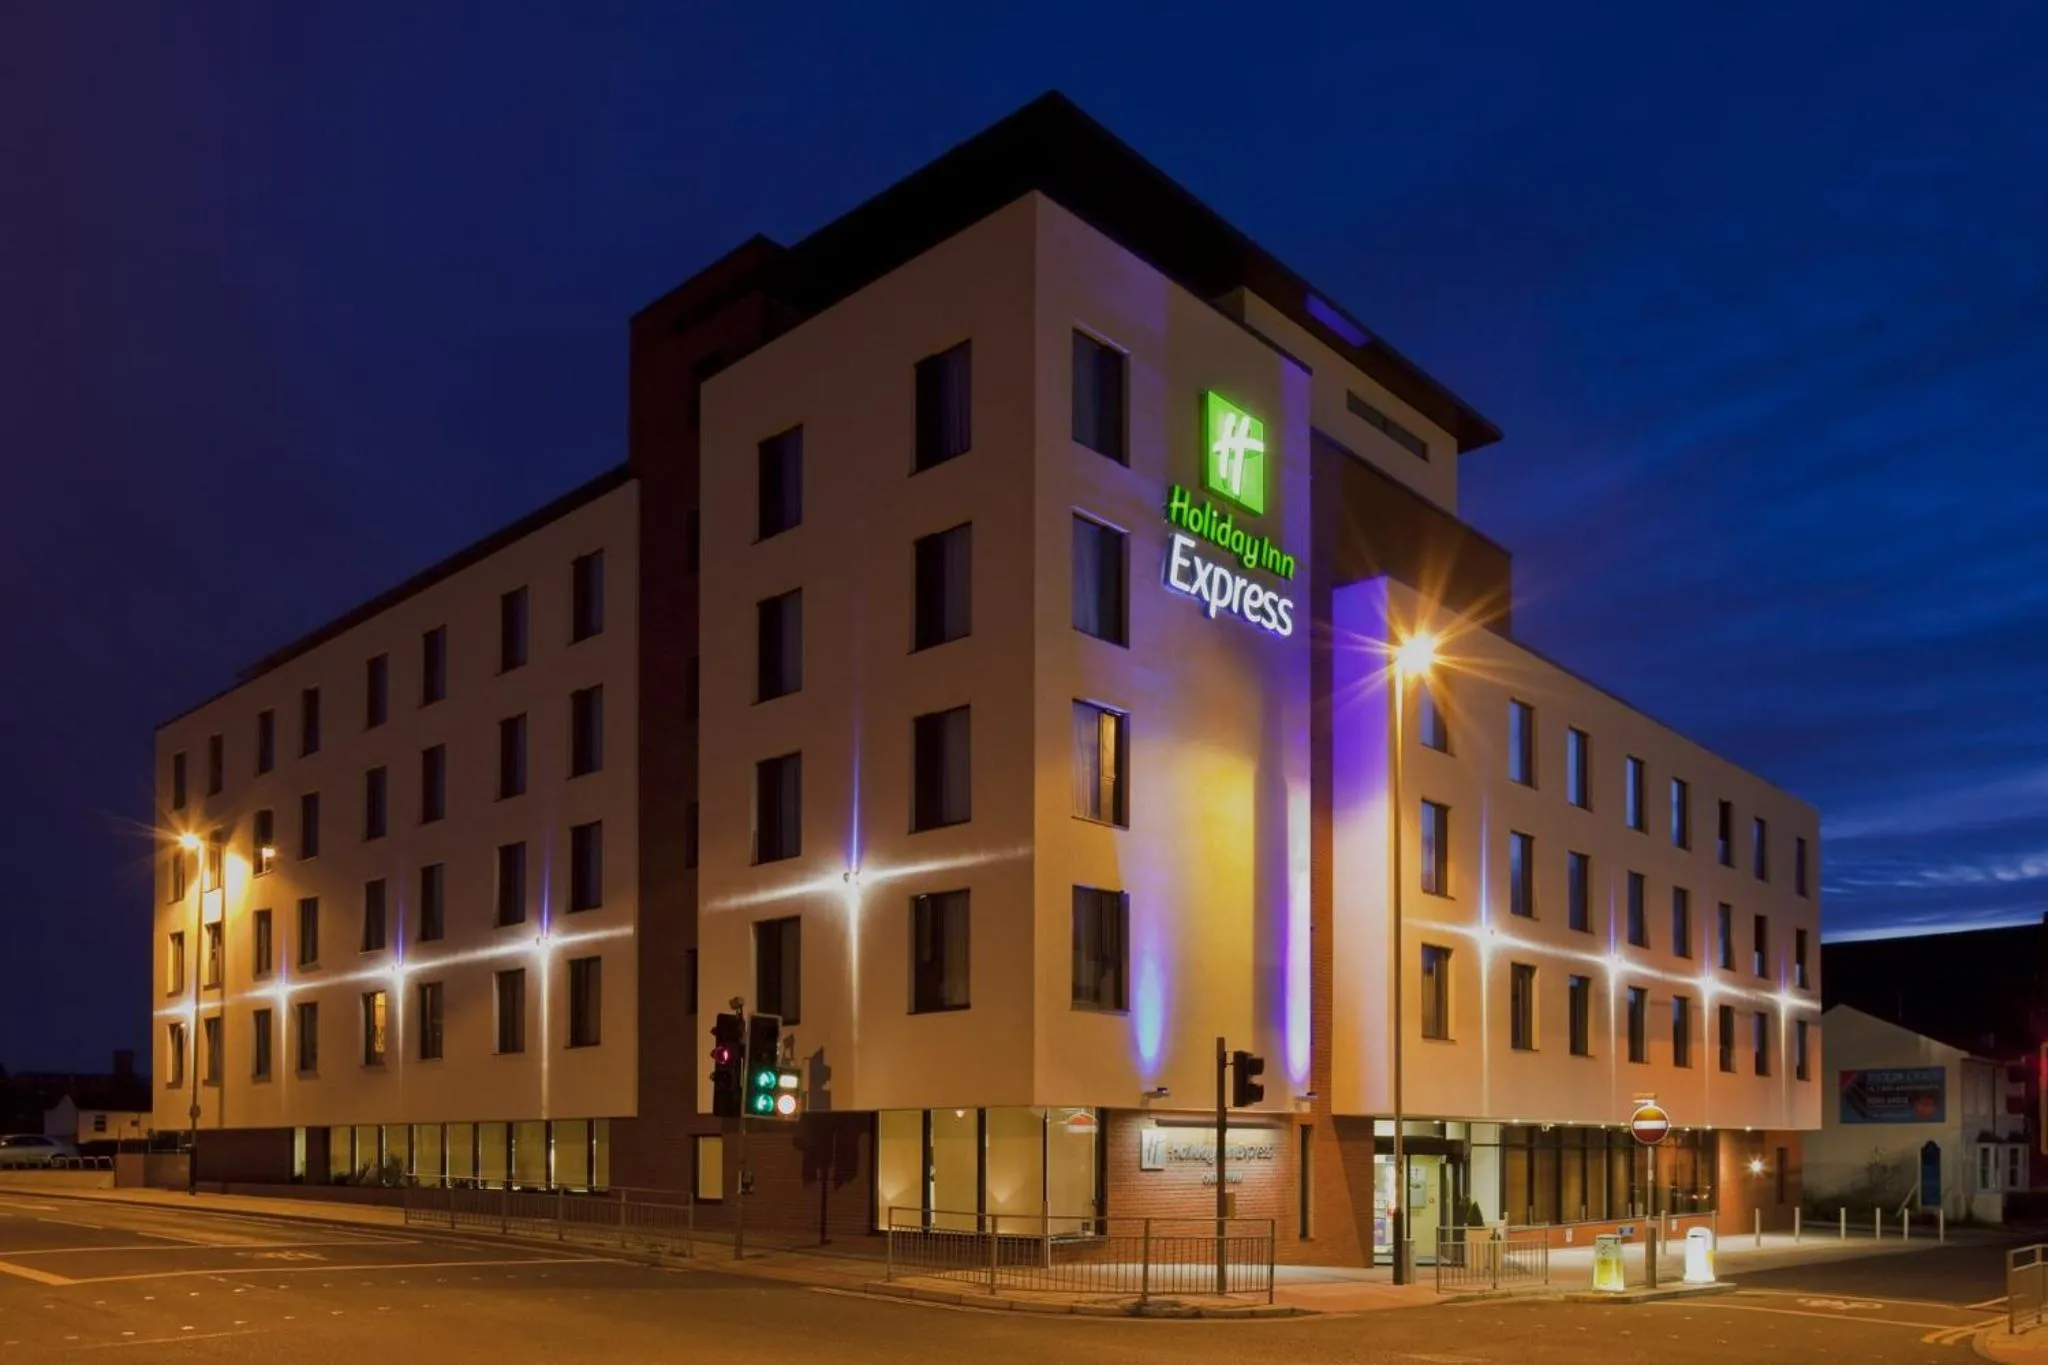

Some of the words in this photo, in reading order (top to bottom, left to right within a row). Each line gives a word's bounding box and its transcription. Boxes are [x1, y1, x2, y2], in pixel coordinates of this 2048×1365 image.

[1169, 484, 1259, 568] Holiday
[1262, 536, 1295, 580] Inn
[1168, 532, 1294, 637] Express
